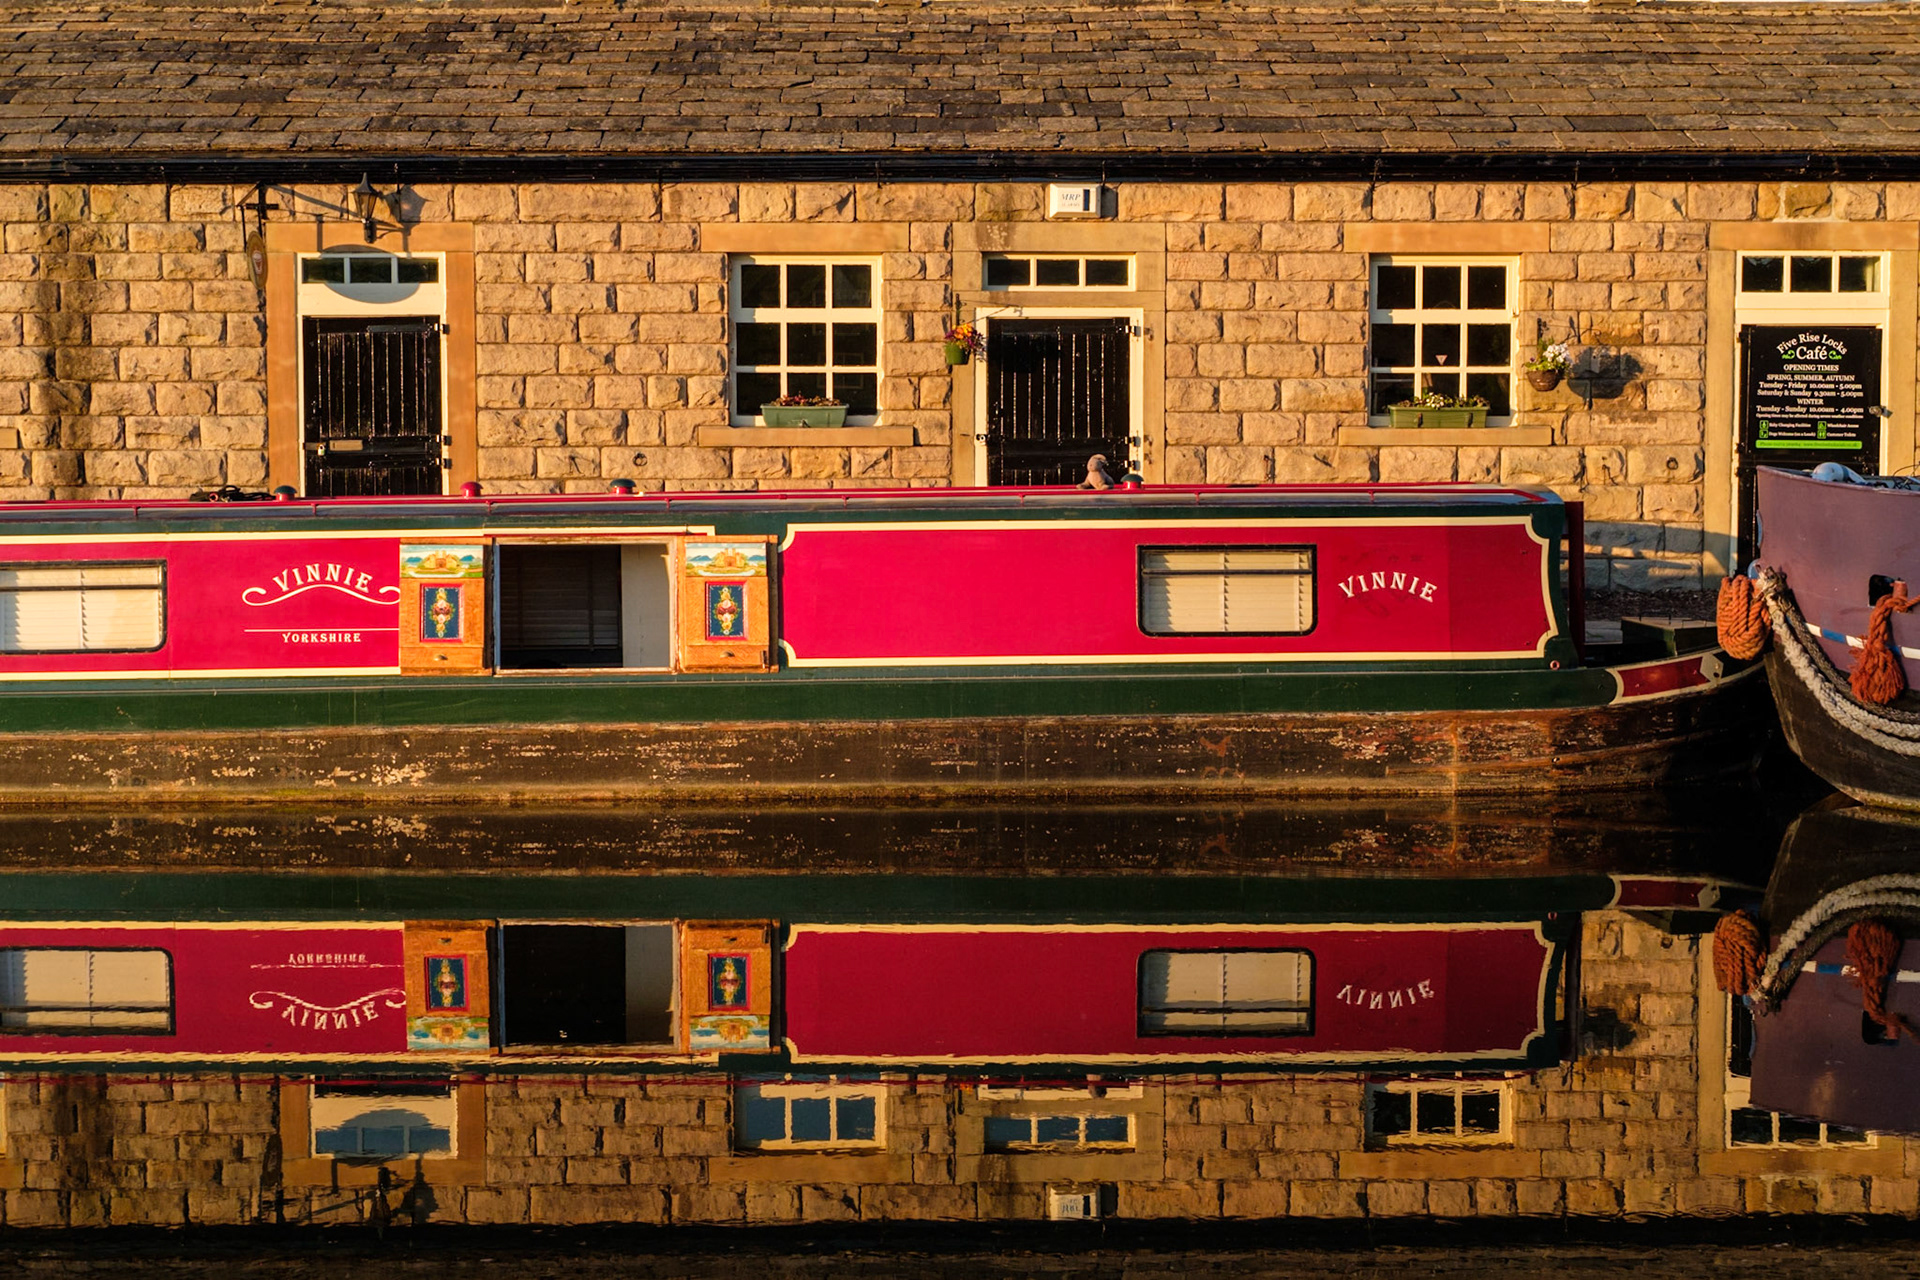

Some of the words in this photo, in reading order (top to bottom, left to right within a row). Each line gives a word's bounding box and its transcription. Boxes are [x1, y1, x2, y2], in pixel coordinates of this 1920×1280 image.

[1061, 193, 1081, 201] MRP
[1776, 338, 1798, 354] Five
[1798, 332, 1820, 343] Rise
[1821, 334, 1848, 355] Locks
[1796, 346, 1828, 360] Café
[1783, 364, 1816, 372] OPENING
[1817, 364, 1839, 372] TIMES
[1757, 389, 1784, 397] Saturday
[1756, 405, 1781, 413] Tuesday
[272, 563, 373, 594] VINNIE
[1338, 571, 1438, 603] VINNIE
[282, 632, 362, 643] YORKSHIRE
